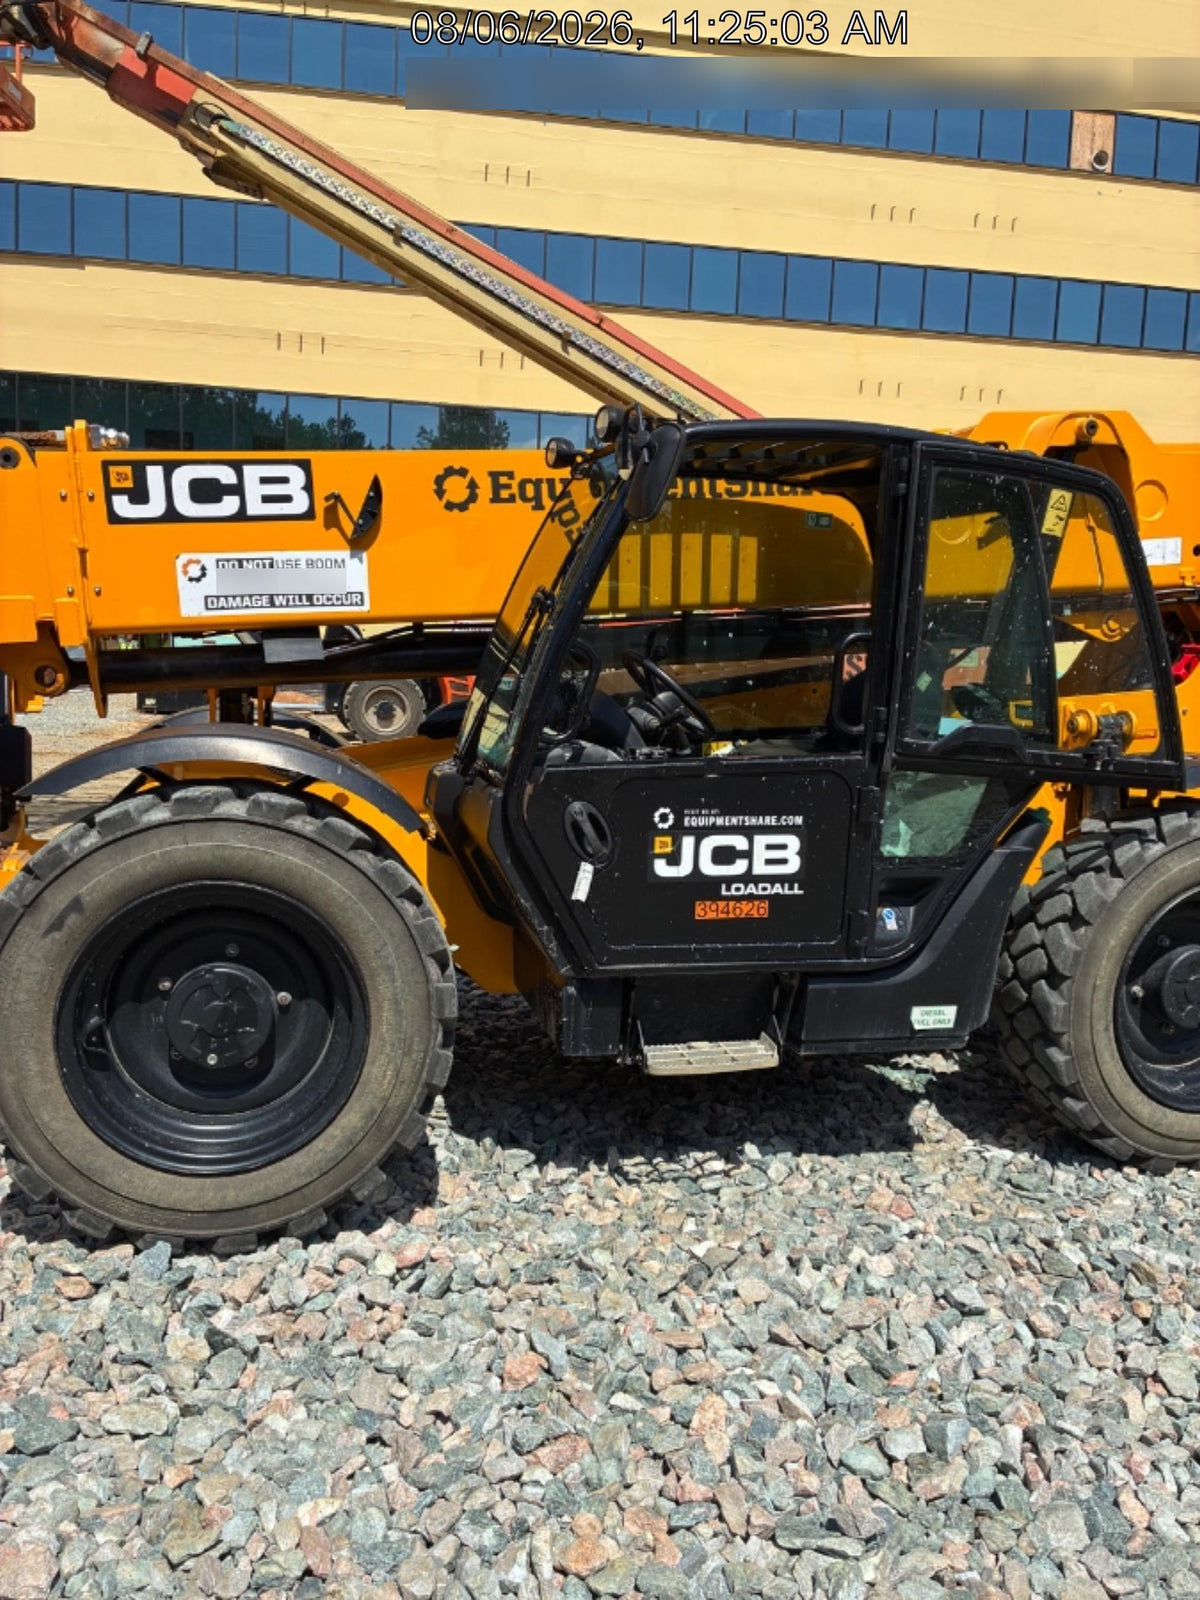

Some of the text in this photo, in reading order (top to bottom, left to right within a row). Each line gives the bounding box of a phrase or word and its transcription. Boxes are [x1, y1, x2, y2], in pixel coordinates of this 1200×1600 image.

[111, 464, 311, 519] JCB
[218, 558, 345, 568] DO NOT USE BOOM
[207, 593, 362, 609] DAMAGE WILL OCCUR
[684, 815, 803, 827] EQUIPMENTSHARE.COM
[653, 834, 801, 877] JCB
[721, 883, 804, 895] LOADALL
[696, 901, 767, 918] 394626
